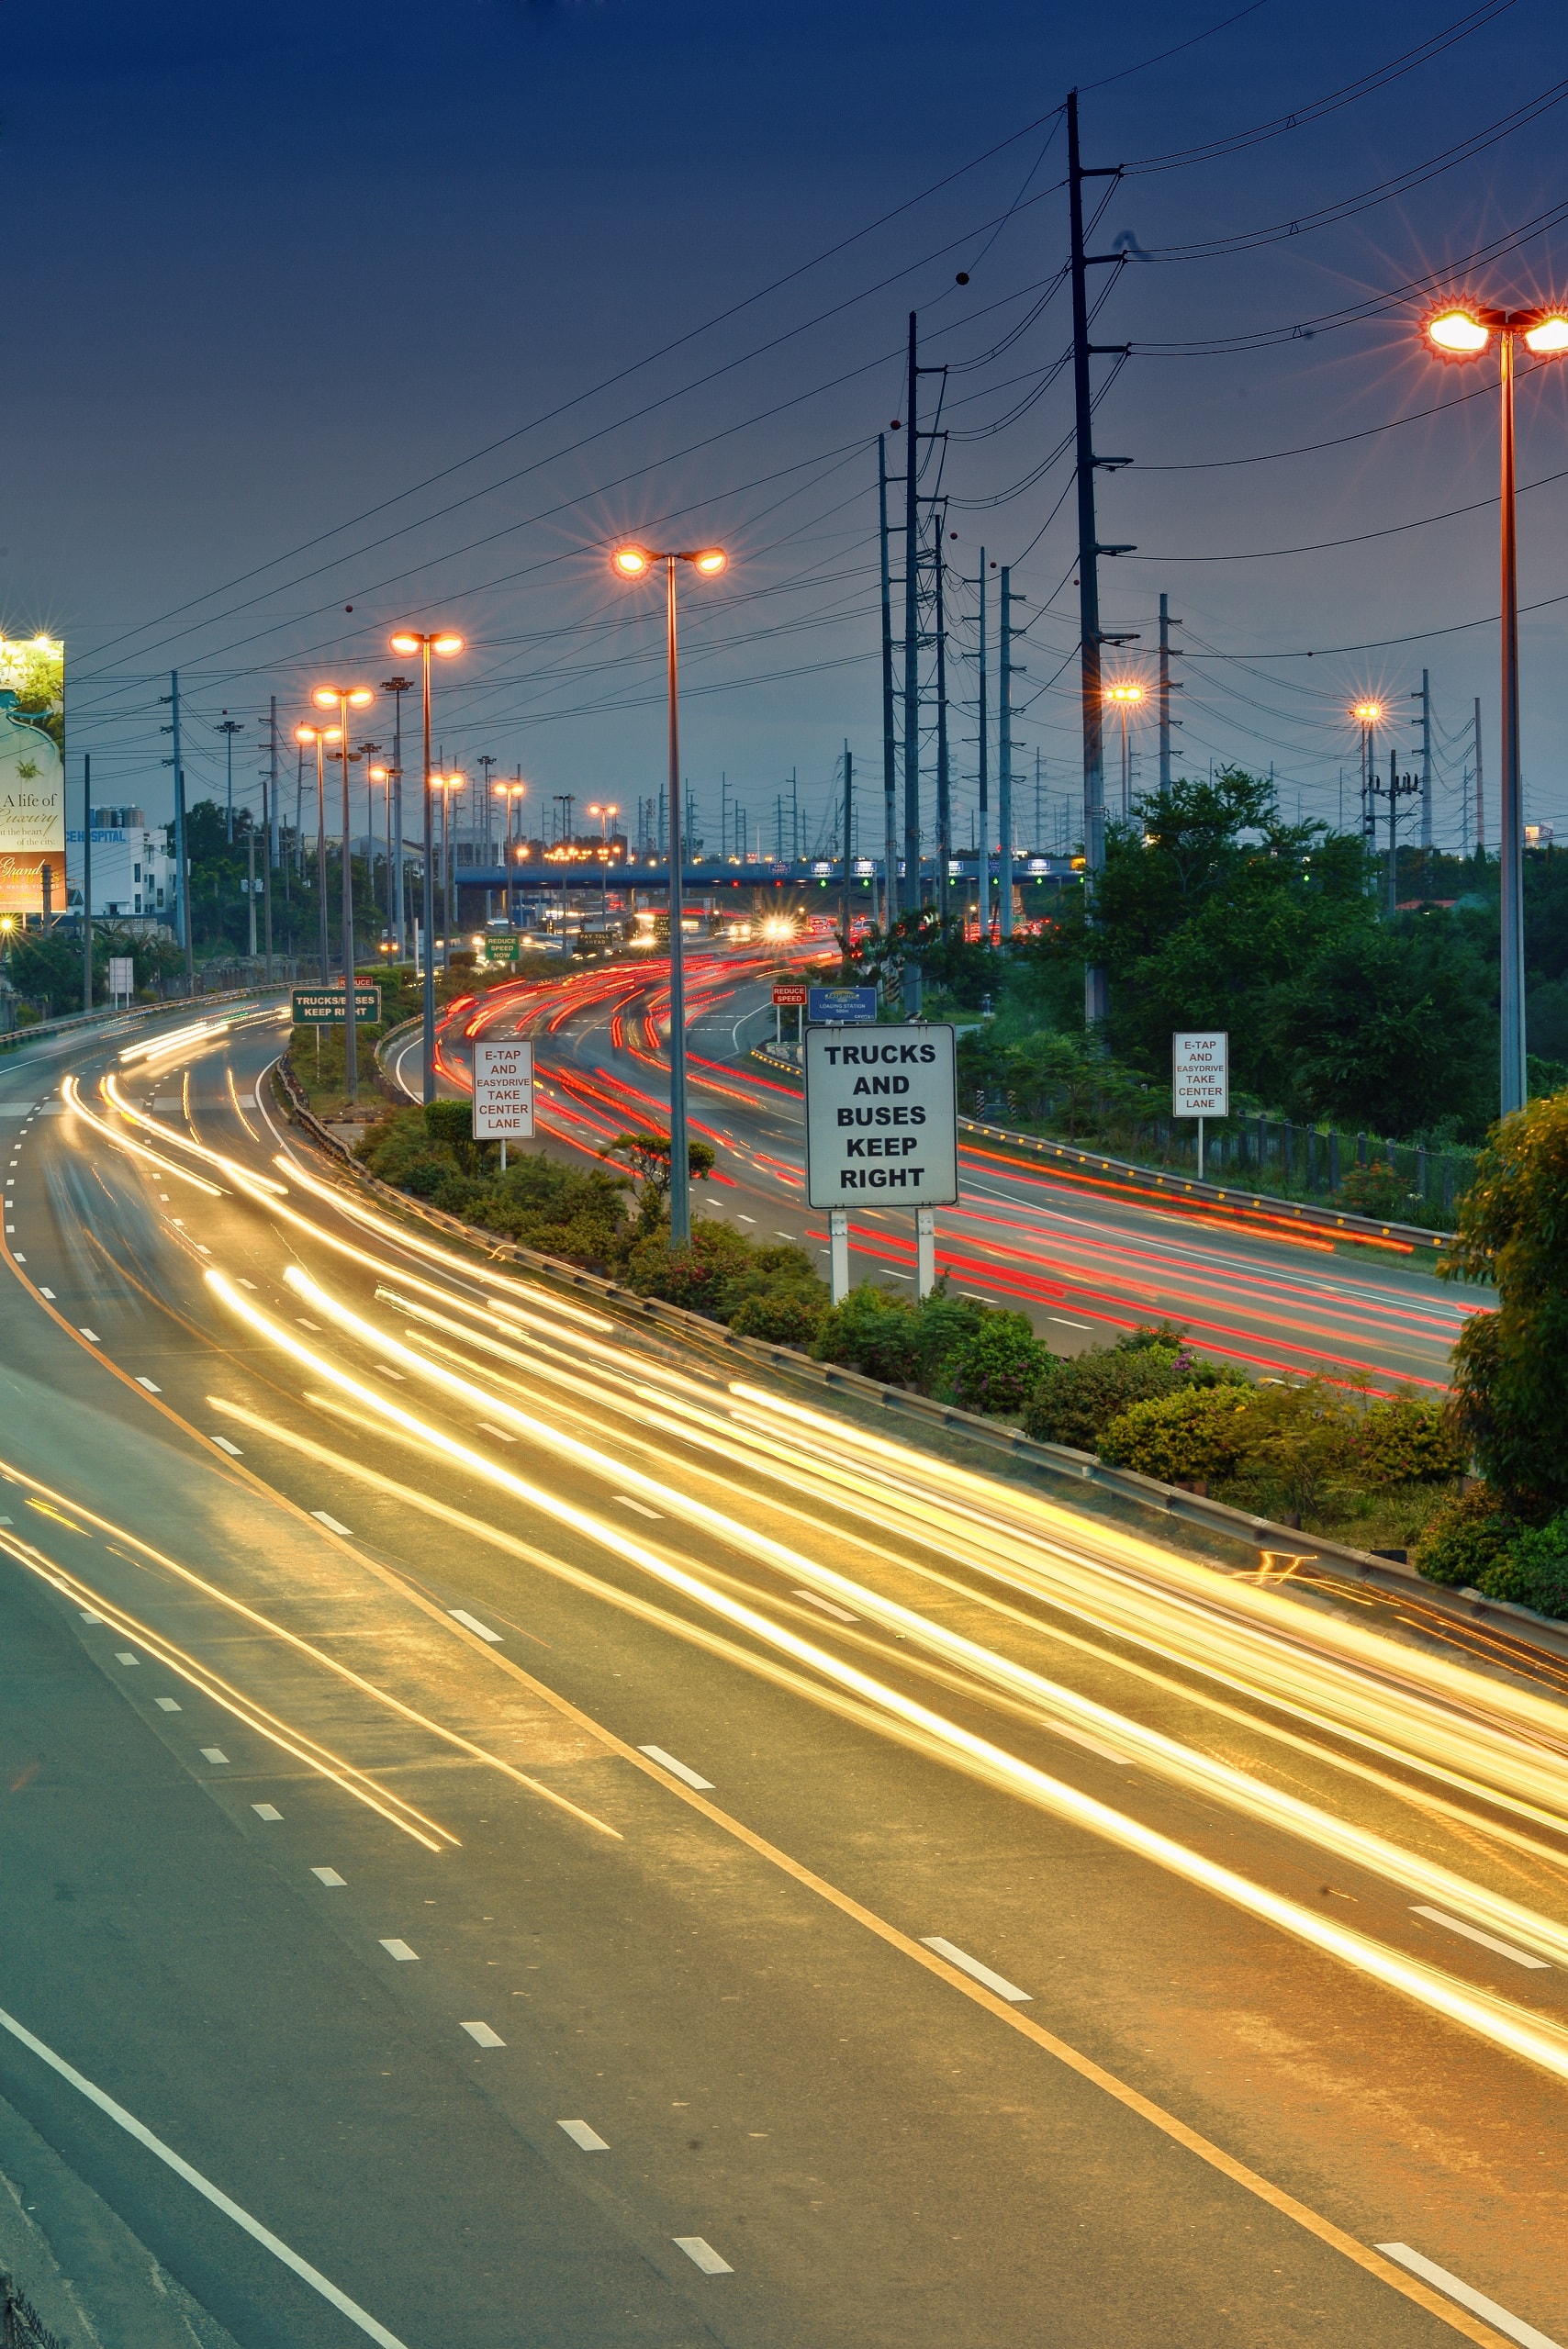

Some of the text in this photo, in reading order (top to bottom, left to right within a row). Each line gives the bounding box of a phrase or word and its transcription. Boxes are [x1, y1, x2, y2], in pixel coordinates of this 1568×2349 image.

[4, 794, 57, 807] A life of
[78, 831, 126, 842] HSPITAL
[0, 856, 45, 878] Grand
[296, 997, 375, 1005] TRUCKS/BSES
[304, 1008, 366, 1016] KEEP RIHT
[1184, 1041, 1216, 1049] E-TAP
[485, 1051, 521, 1060] E-TAP
[824, 1045, 935, 1065] TRUCKS
[1190, 1053, 1212, 1061] AND
[490, 1065, 517, 1074] AND
[477, 1079, 530, 1087] EASYDRIVE
[1186, 1075, 1215, 1083] TAKE
[853, 1076, 909, 1095] AND
[487, 1091, 521, 1100] TAKE
[1179, 1088, 1223, 1096] CENTER
[1186, 1100, 1215, 1108] LANE
[479, 1104, 529, 1114] CENTER
[837, 1106, 926, 1126] BUSES
[488, 1119, 521, 1128] LANE
[846, 1137, 917, 1157] KEEP
[840, 1168, 924, 1188] RIGHT
